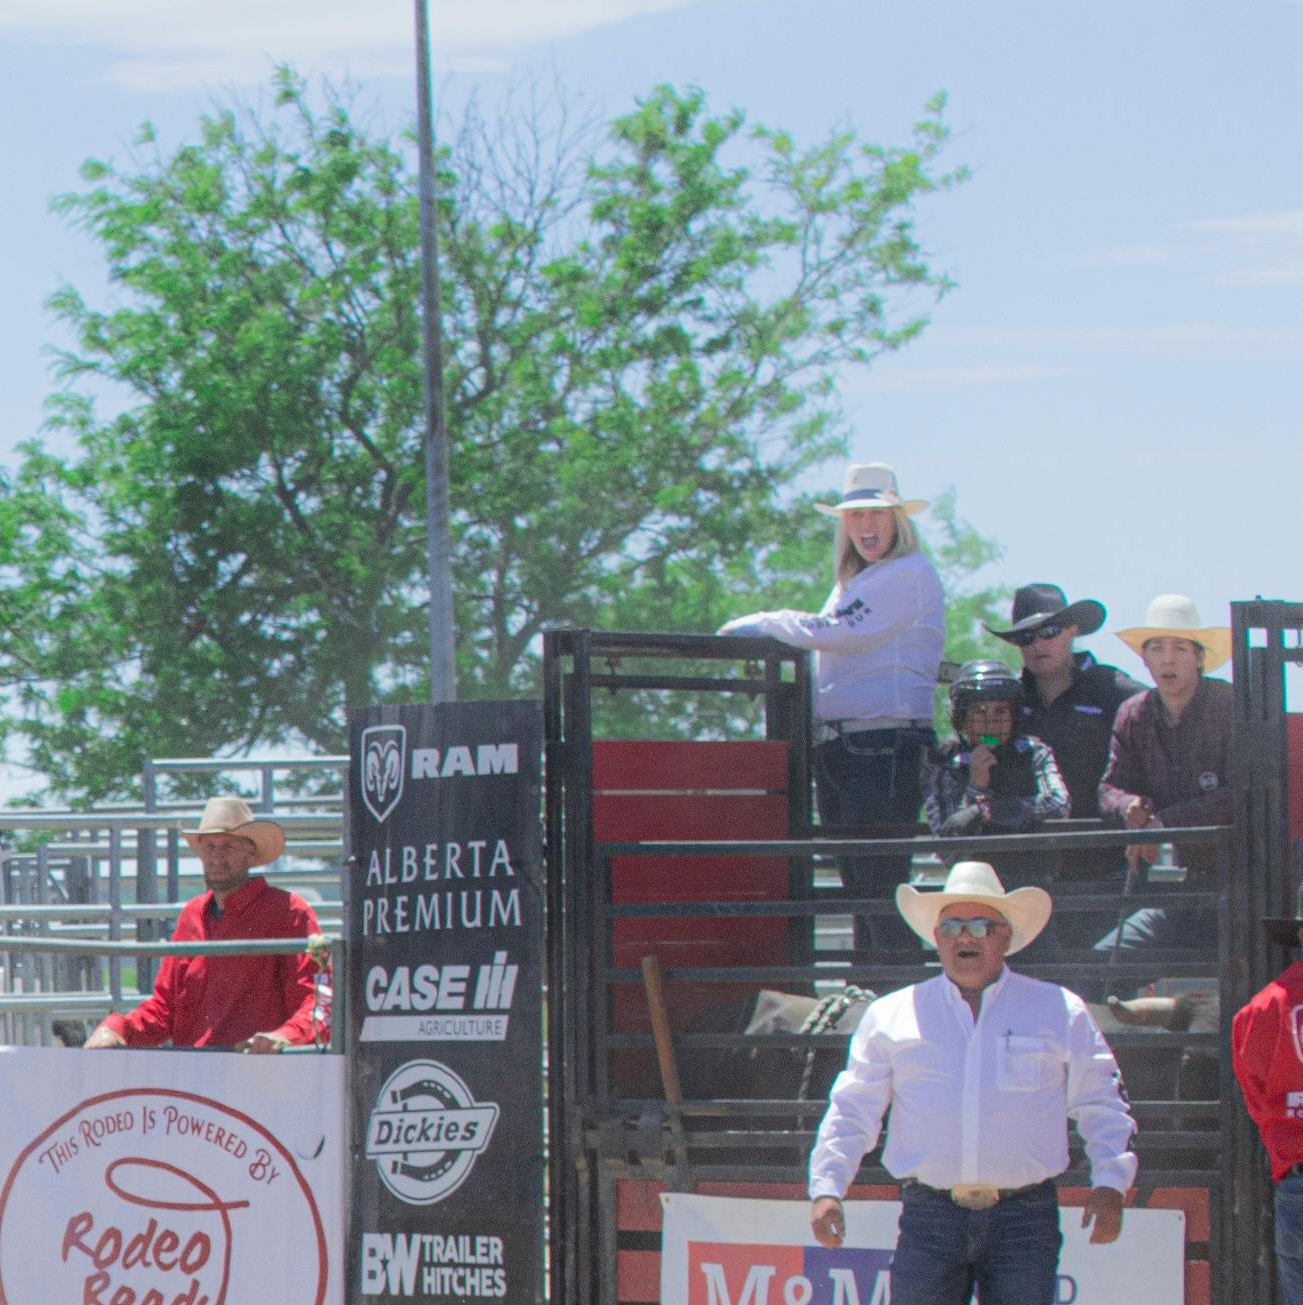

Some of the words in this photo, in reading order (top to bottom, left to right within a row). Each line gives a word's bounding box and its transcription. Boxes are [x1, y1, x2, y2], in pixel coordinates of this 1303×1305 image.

[411, 743, 519, 779] RAM
[366, 839, 515, 887] ALBERTA
[362, 889, 522, 936] PREMIUM
[365, 963, 470, 1011] CASE
[418, 1019, 502, 1037] AGRICULTURE
[374, 1119, 479, 1147] Dickies
[61, 1211, 211, 1276] Rodeo
[422, 1235, 504, 1265] TRAILER
[422, 1267, 507, 1298] HITCHES
